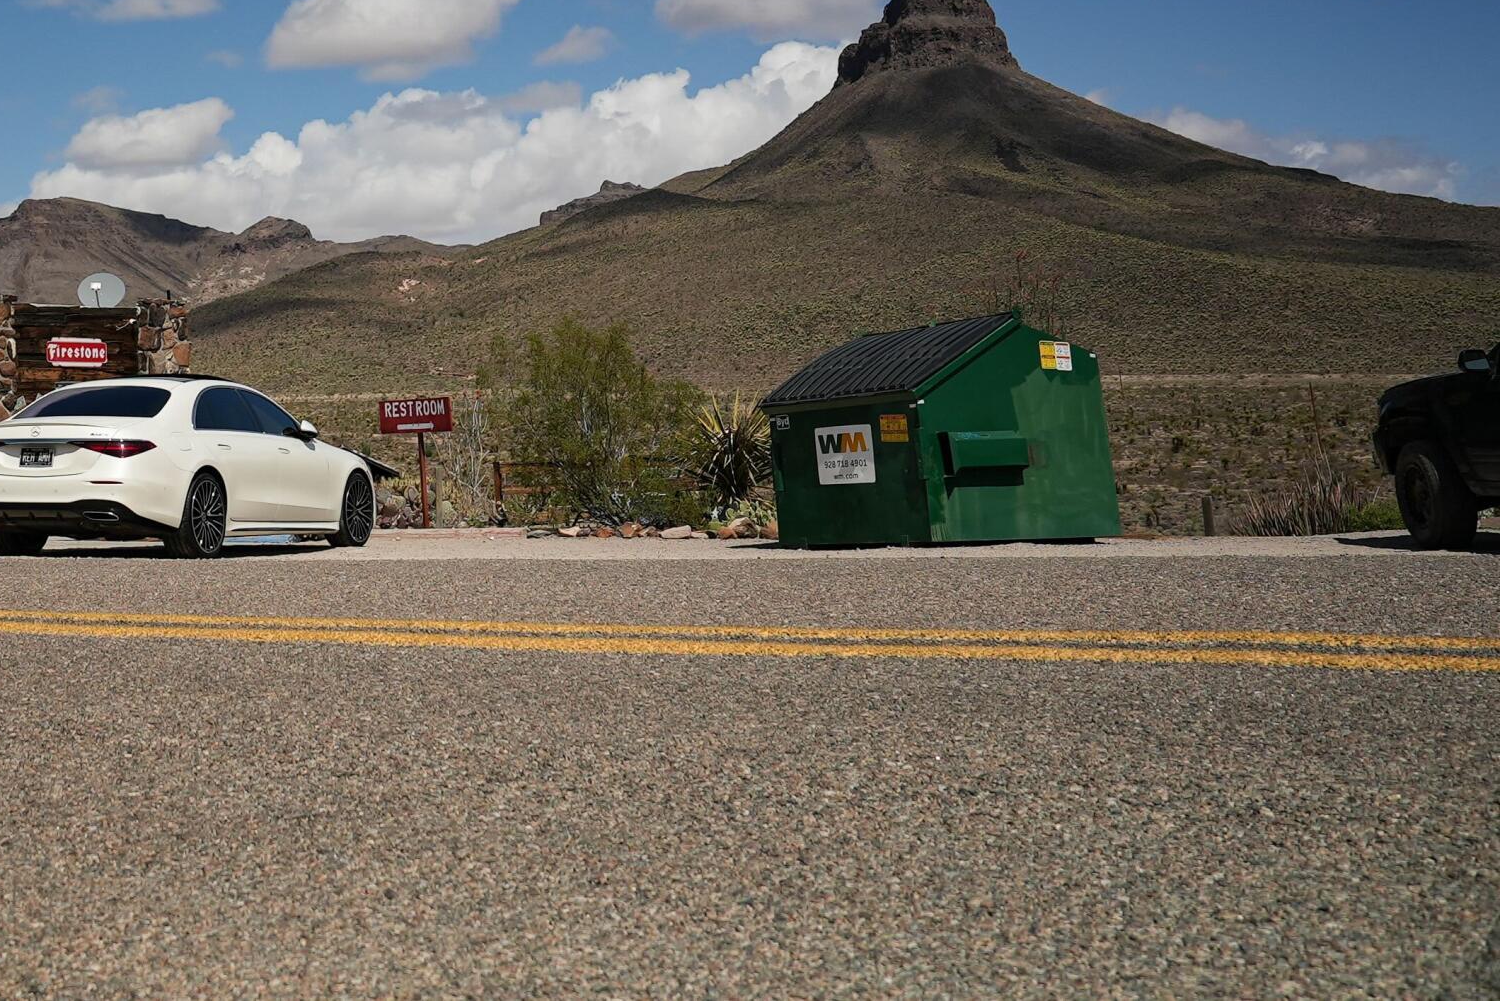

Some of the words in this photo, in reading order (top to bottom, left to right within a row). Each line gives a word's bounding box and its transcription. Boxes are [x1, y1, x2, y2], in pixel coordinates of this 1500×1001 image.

[47, 343, 106, 360] Firestone
[818, 432, 867, 454] WM
[824, 460, 837, 469] 928
[837, 459, 849, 468] 718
[850, 458, 868, 468] 4901
